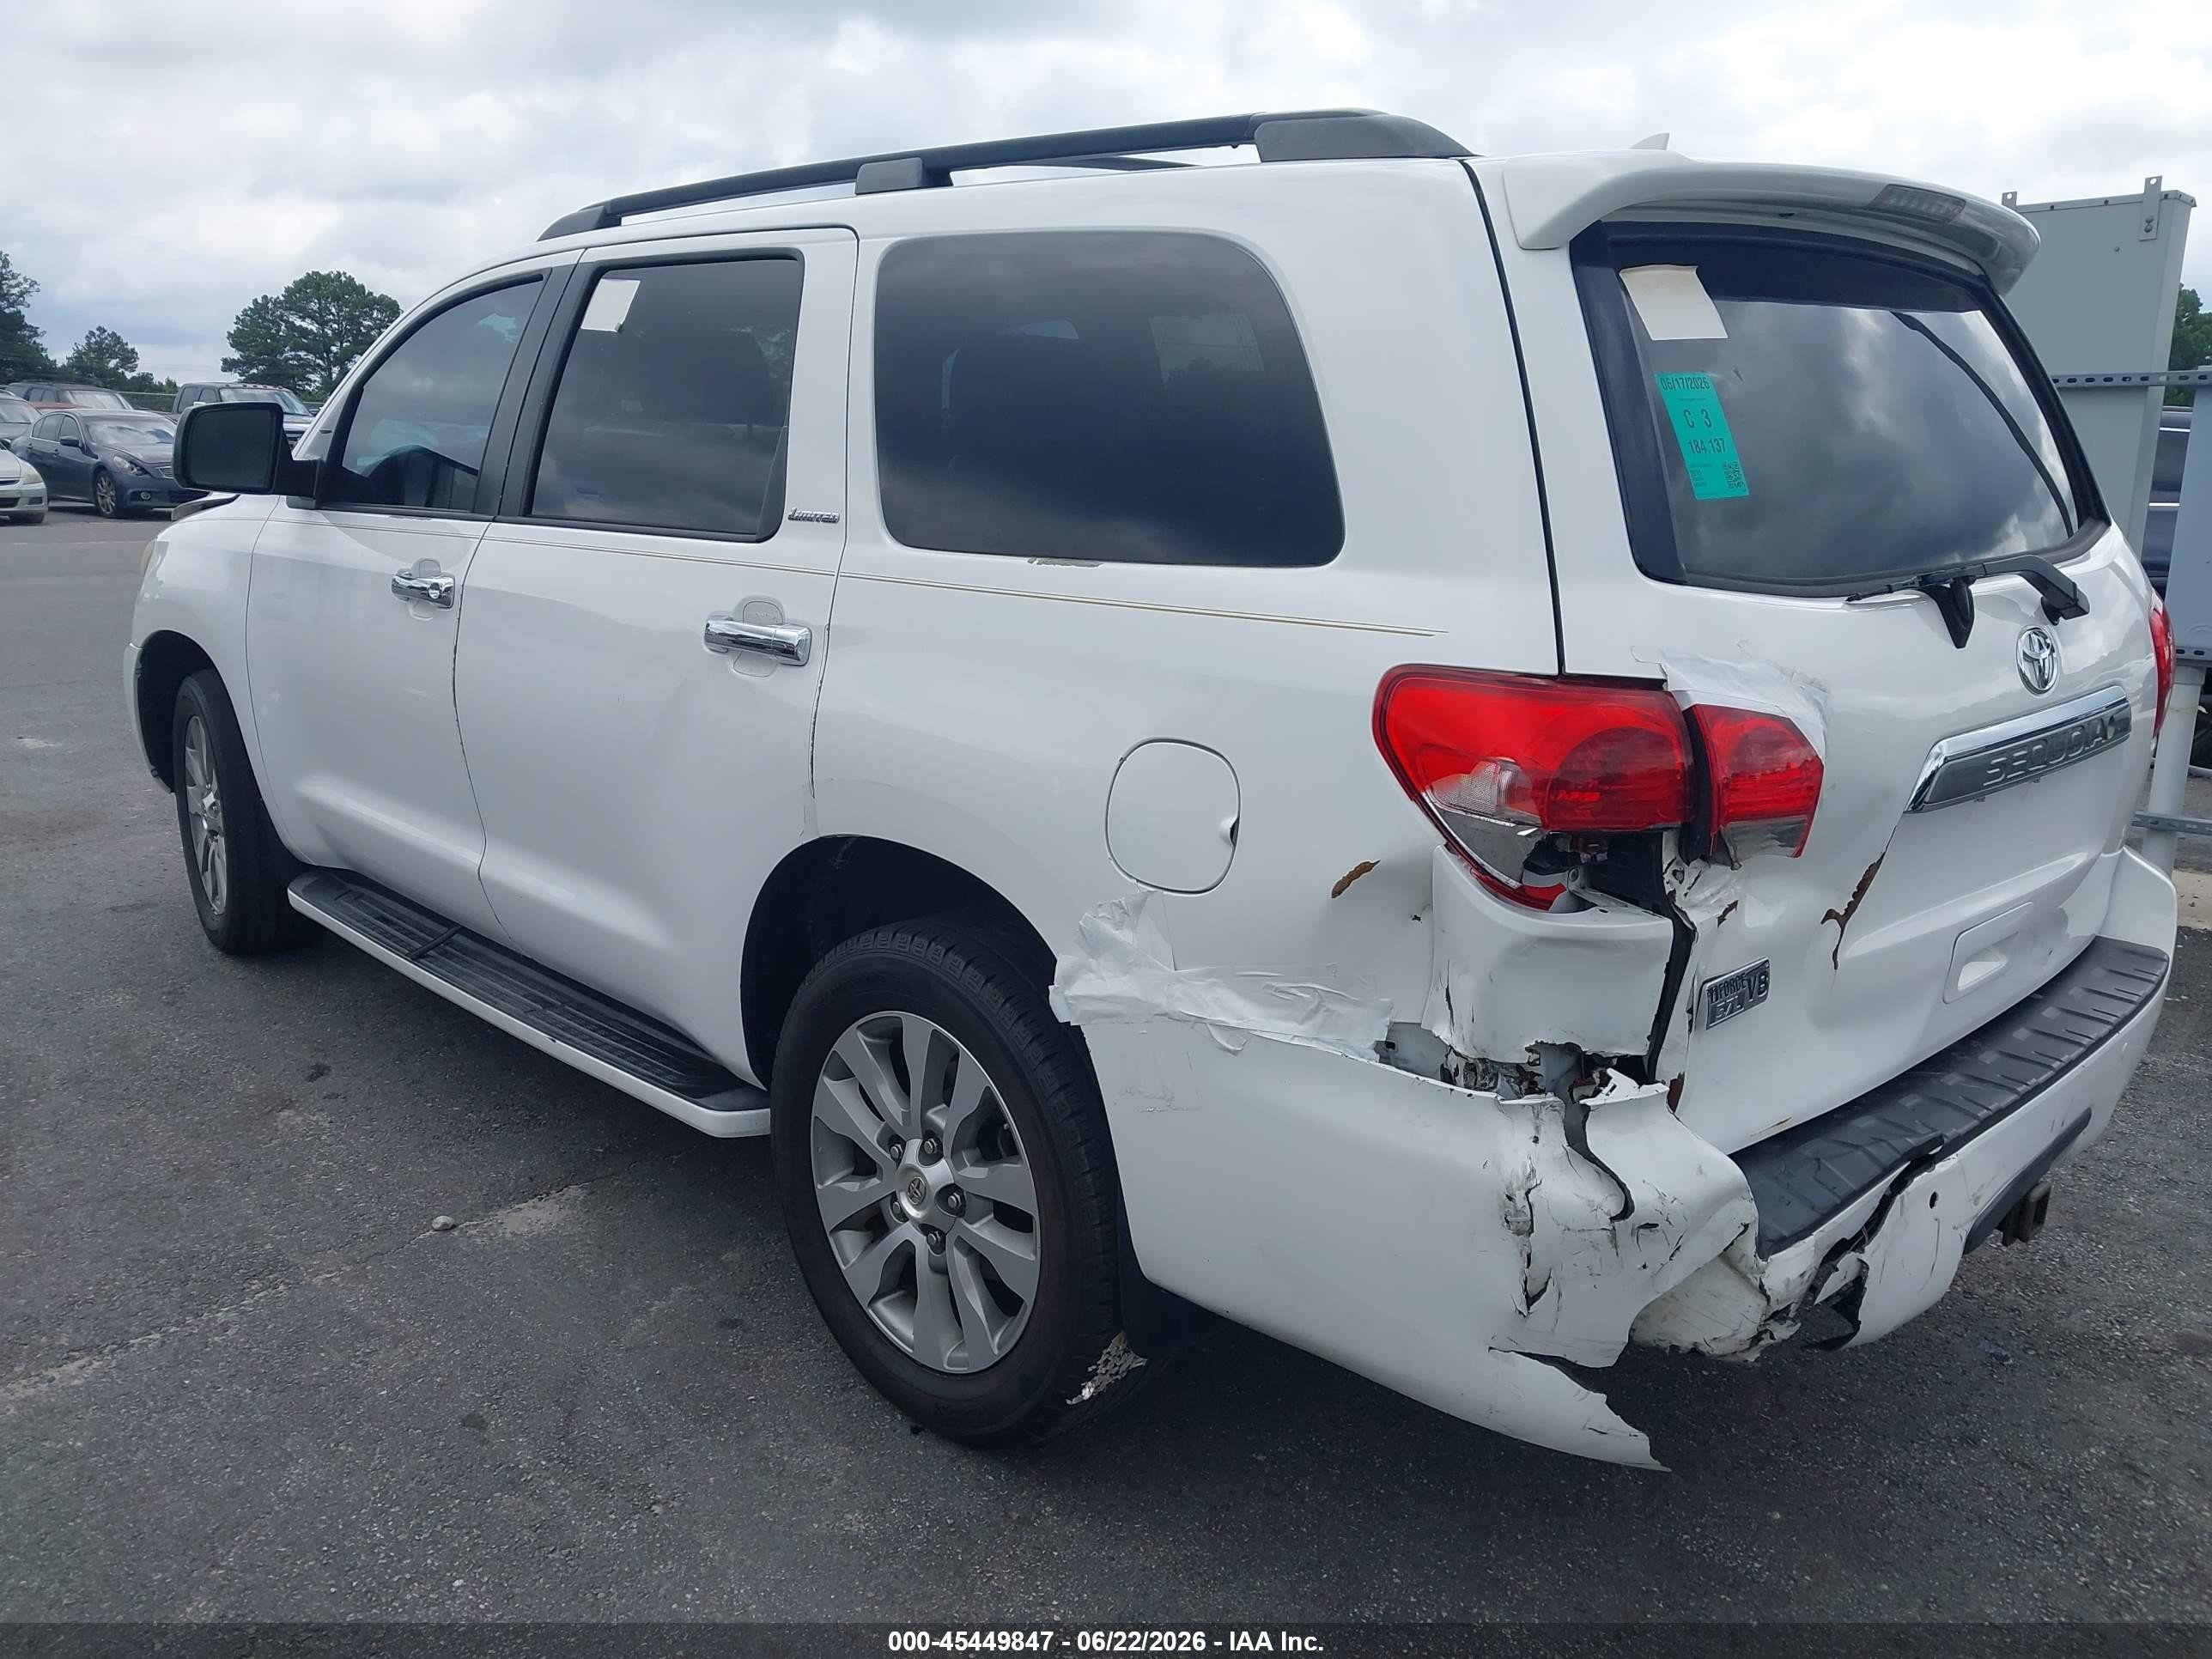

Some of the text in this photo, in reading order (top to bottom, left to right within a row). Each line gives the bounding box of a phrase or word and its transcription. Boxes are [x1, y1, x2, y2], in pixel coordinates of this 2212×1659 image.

[1683, 408, 1712, 428] C 3
[1983, 716, 2106, 787] SEQUOIA
